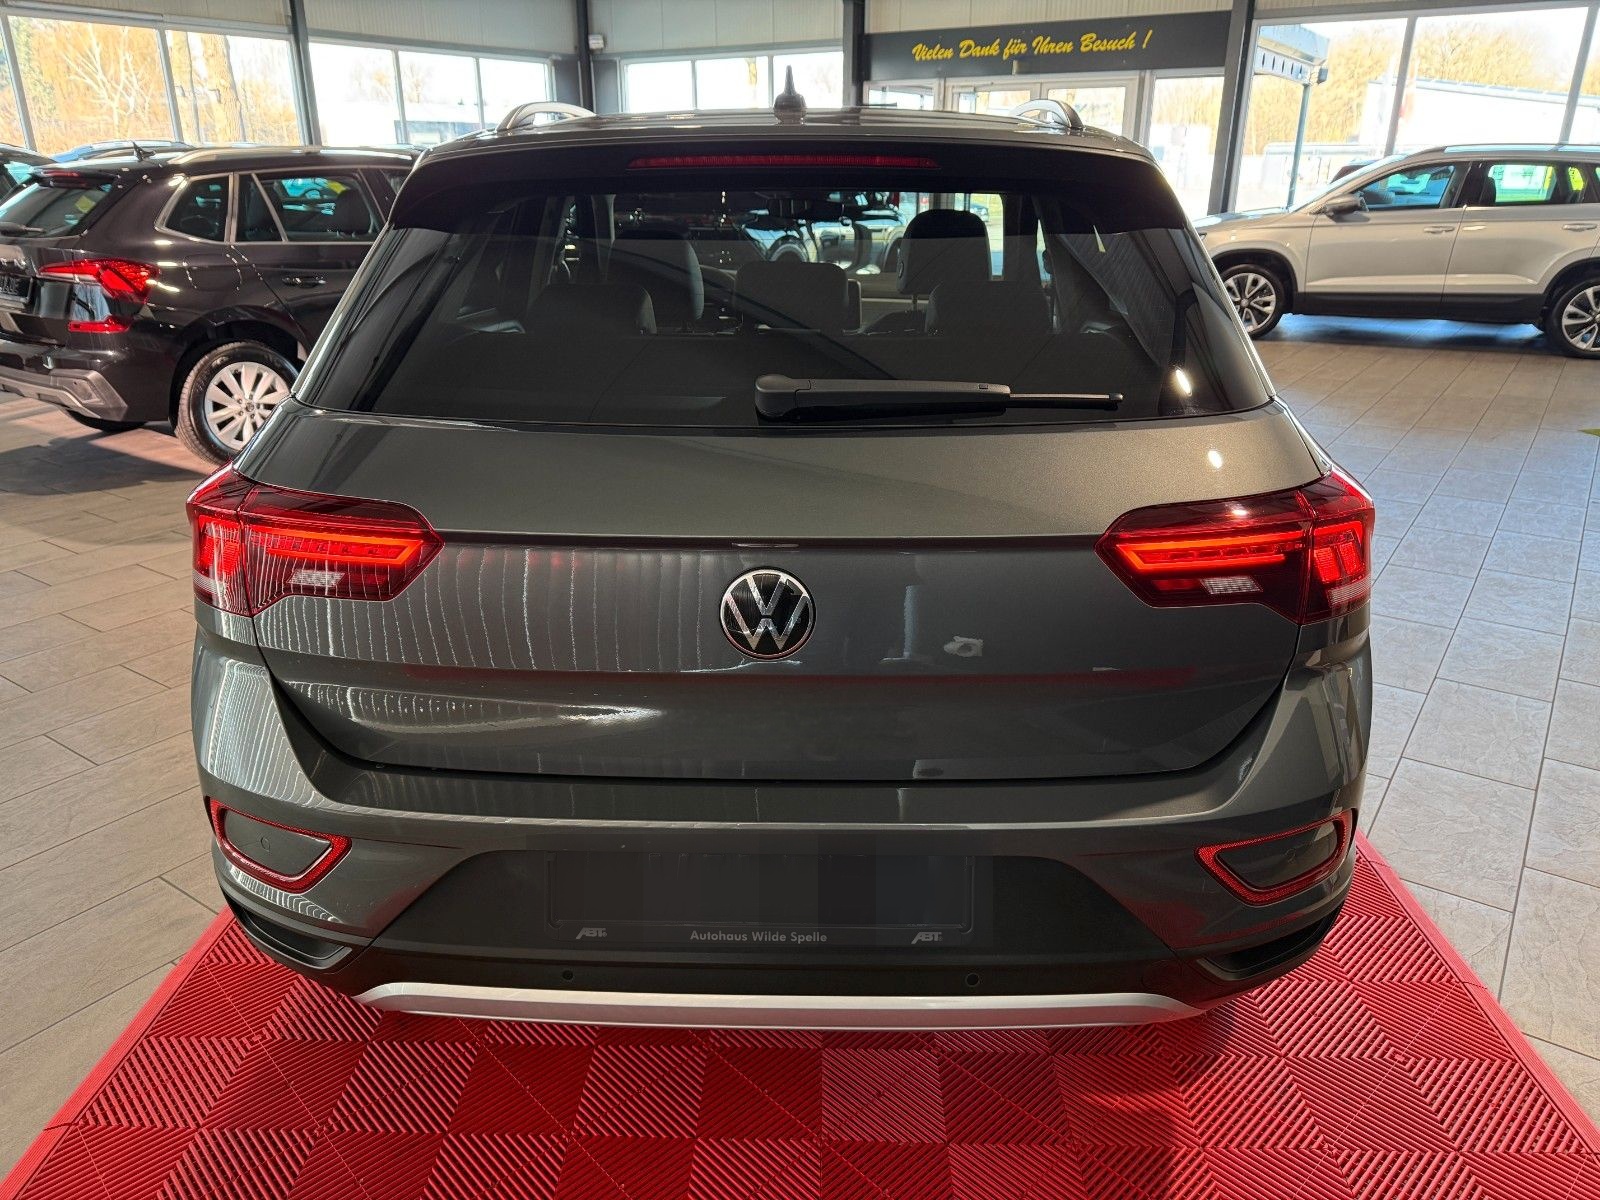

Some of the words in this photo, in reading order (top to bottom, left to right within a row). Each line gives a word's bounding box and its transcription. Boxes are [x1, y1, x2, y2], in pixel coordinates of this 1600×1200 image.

[912, 43, 954, 61] Vielen
[959, 38, 1000, 59] Dank
[1002, 39, 1028, 60] für
[1031, 35, 1074, 54] Ihren
[1079, 32, 1137, 53] Besuch
[689, 930, 748, 942] Autohaus
[751, 931, 787, 942] Wilde
[789, 931, 828, 944] Spelle
